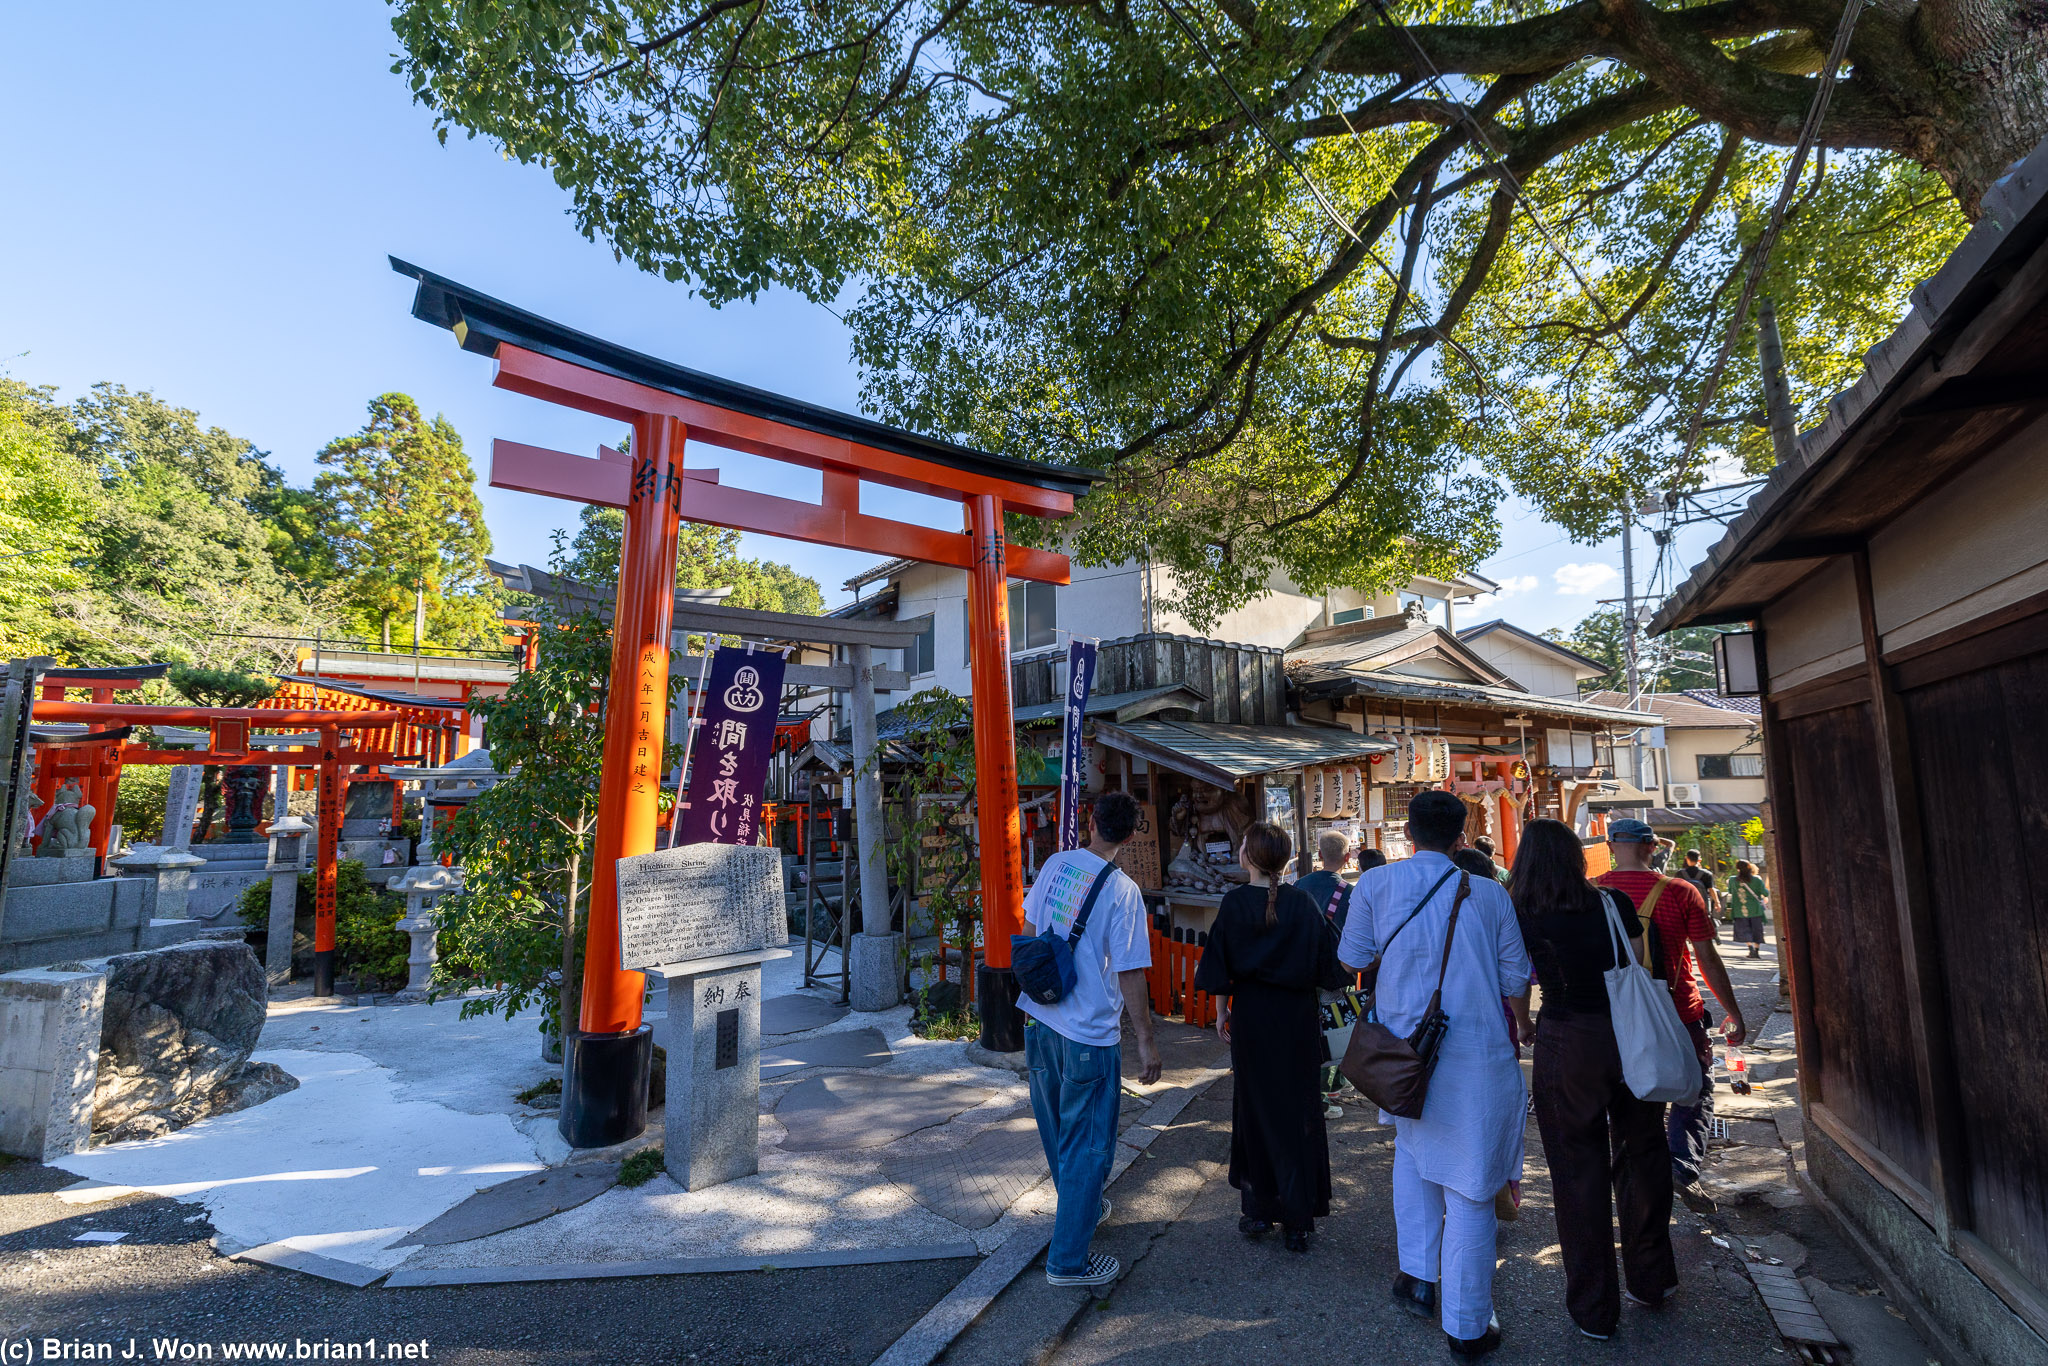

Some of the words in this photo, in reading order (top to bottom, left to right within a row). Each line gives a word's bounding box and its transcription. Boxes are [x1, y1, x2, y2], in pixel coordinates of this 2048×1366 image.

[632, 457, 682, 515] 納
[976, 528, 1007, 574] 奉
[631, 632, 657, 794] 平成八年一月吉日建之
[681, 859, 707, 869] Shrine
[642, 938, 659, 947] lucky
